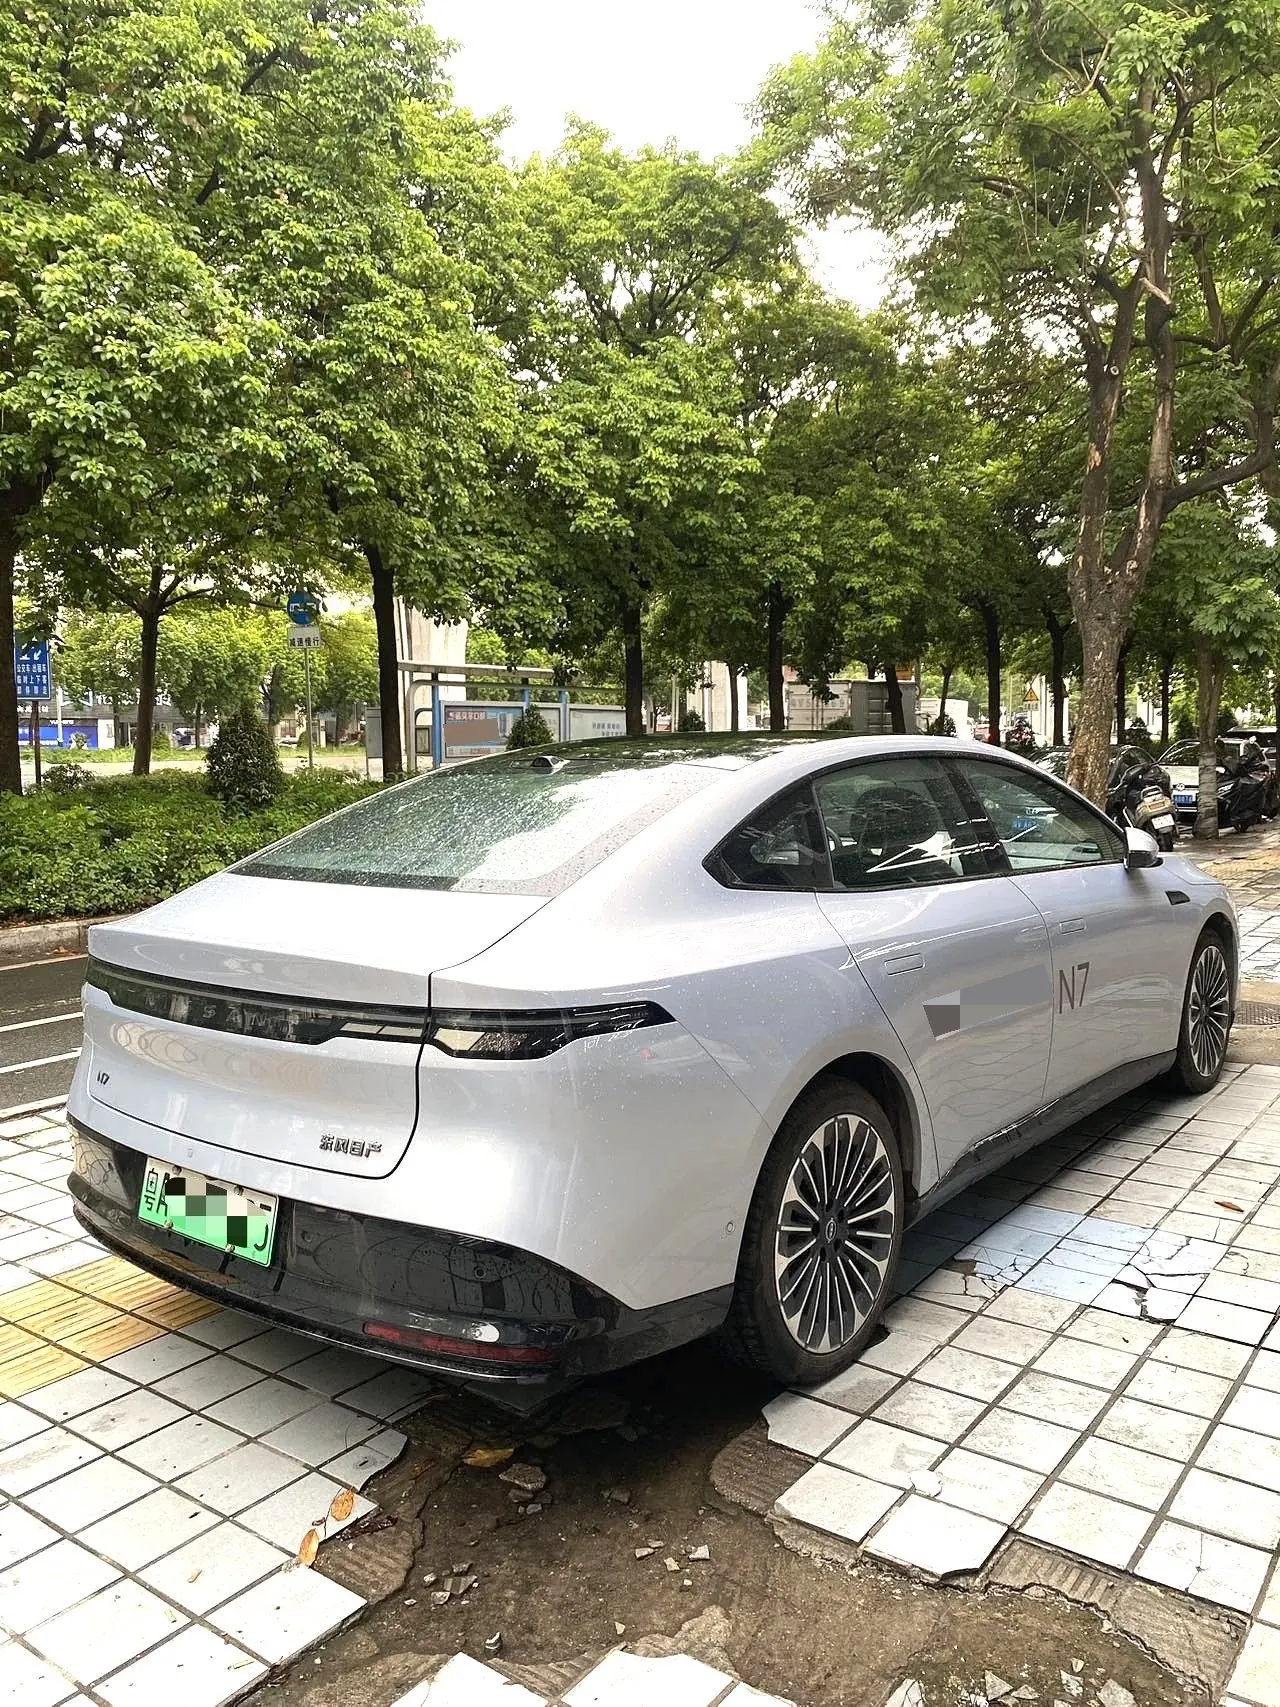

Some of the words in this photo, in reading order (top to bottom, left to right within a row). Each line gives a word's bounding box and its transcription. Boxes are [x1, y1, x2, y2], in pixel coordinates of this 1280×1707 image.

[1058, 961, 1091, 1014] N7
[319, 1135, 383, 1158] 东风日产
